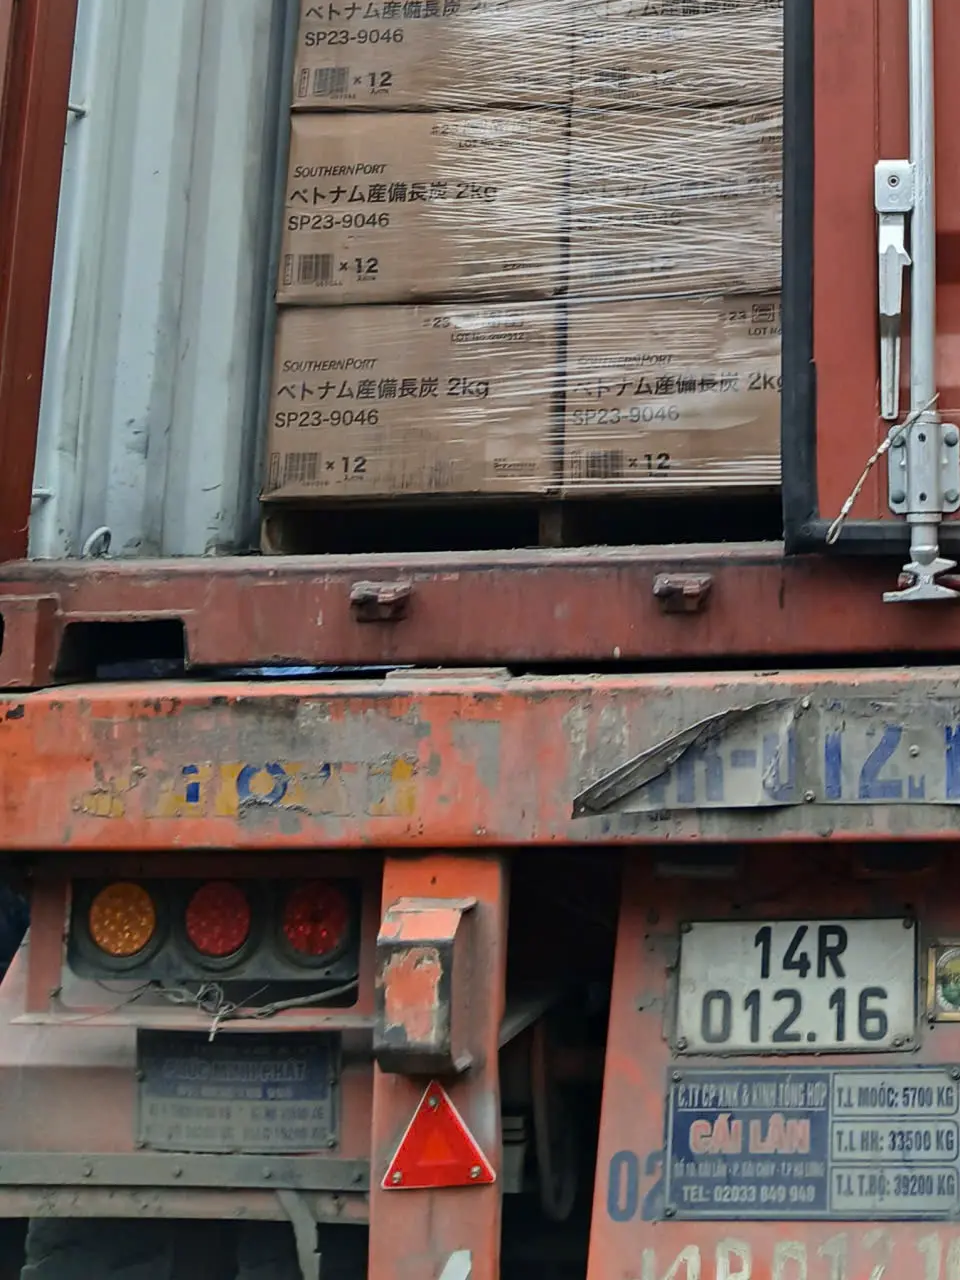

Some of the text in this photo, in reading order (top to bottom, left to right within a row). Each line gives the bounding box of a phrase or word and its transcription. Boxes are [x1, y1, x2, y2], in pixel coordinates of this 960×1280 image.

[304, 29, 404, 47] SP23-9046
[368, 71, 393, 88] 12
[287, 212, 389, 231] SP23-9046
[354, 256, 379, 274] 12
[748, 326, 767, 337] LOT
[277, 376, 490, 401] ベトナム産備長炭 2kg
[274, 408, 379, 428] SP23-9046
[571, 404, 680, 426] SP23-9046
[342, 456, 368, 473] 12
[644, 452, 671, 470] 12
[754, 924, 848, 980] 14R
[702, 986, 889, 1044] 012.16
[902, 1086, 934, 1108] 5700
[937, 1086, 954, 1108] KG
[936, 1130, 954, 1152] KG
[937, 1174, 955, 1196] KG
